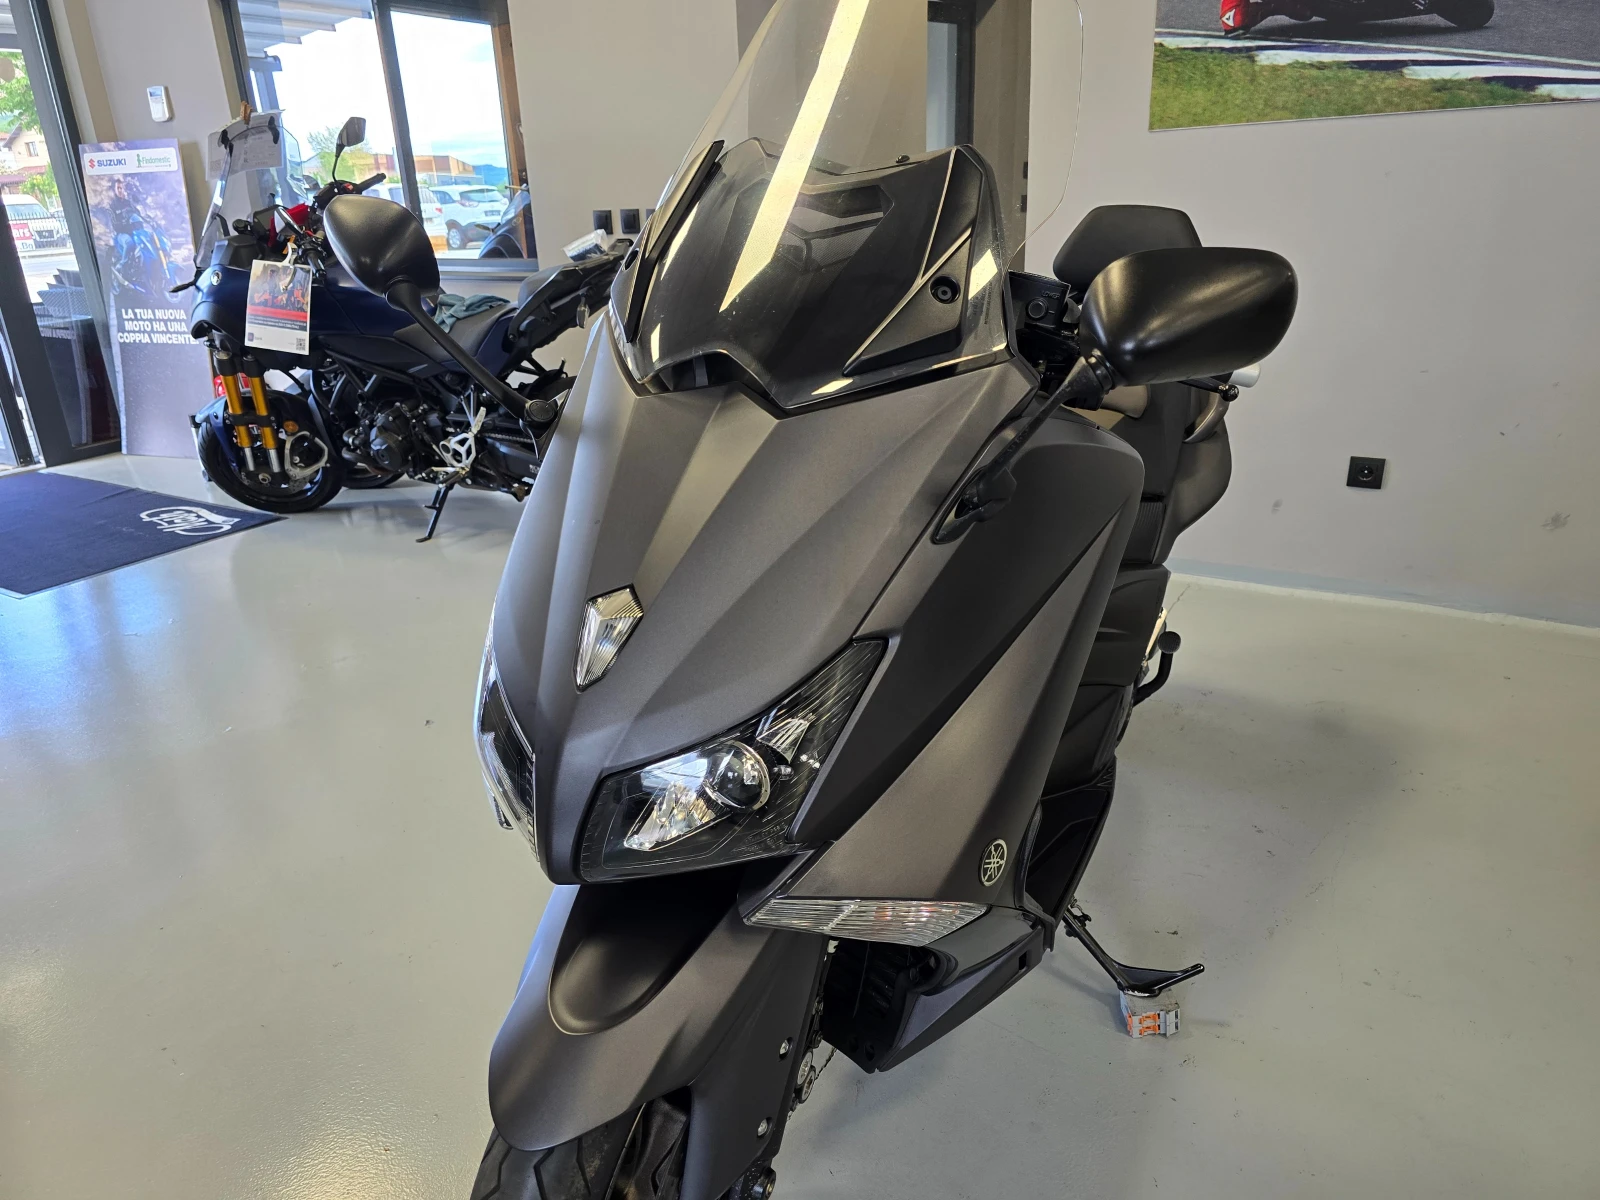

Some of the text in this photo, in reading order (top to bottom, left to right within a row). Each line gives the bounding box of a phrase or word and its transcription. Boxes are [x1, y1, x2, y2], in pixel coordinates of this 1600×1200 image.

[97, 158, 127, 167] SUZUKI
[142, 156, 171, 165] Findomestic
[121, 308, 187, 320] LA TUA NUOVA
[124, 320, 188, 333] MOTO HA UNA
[117, 332, 152, 344] COPPIA
